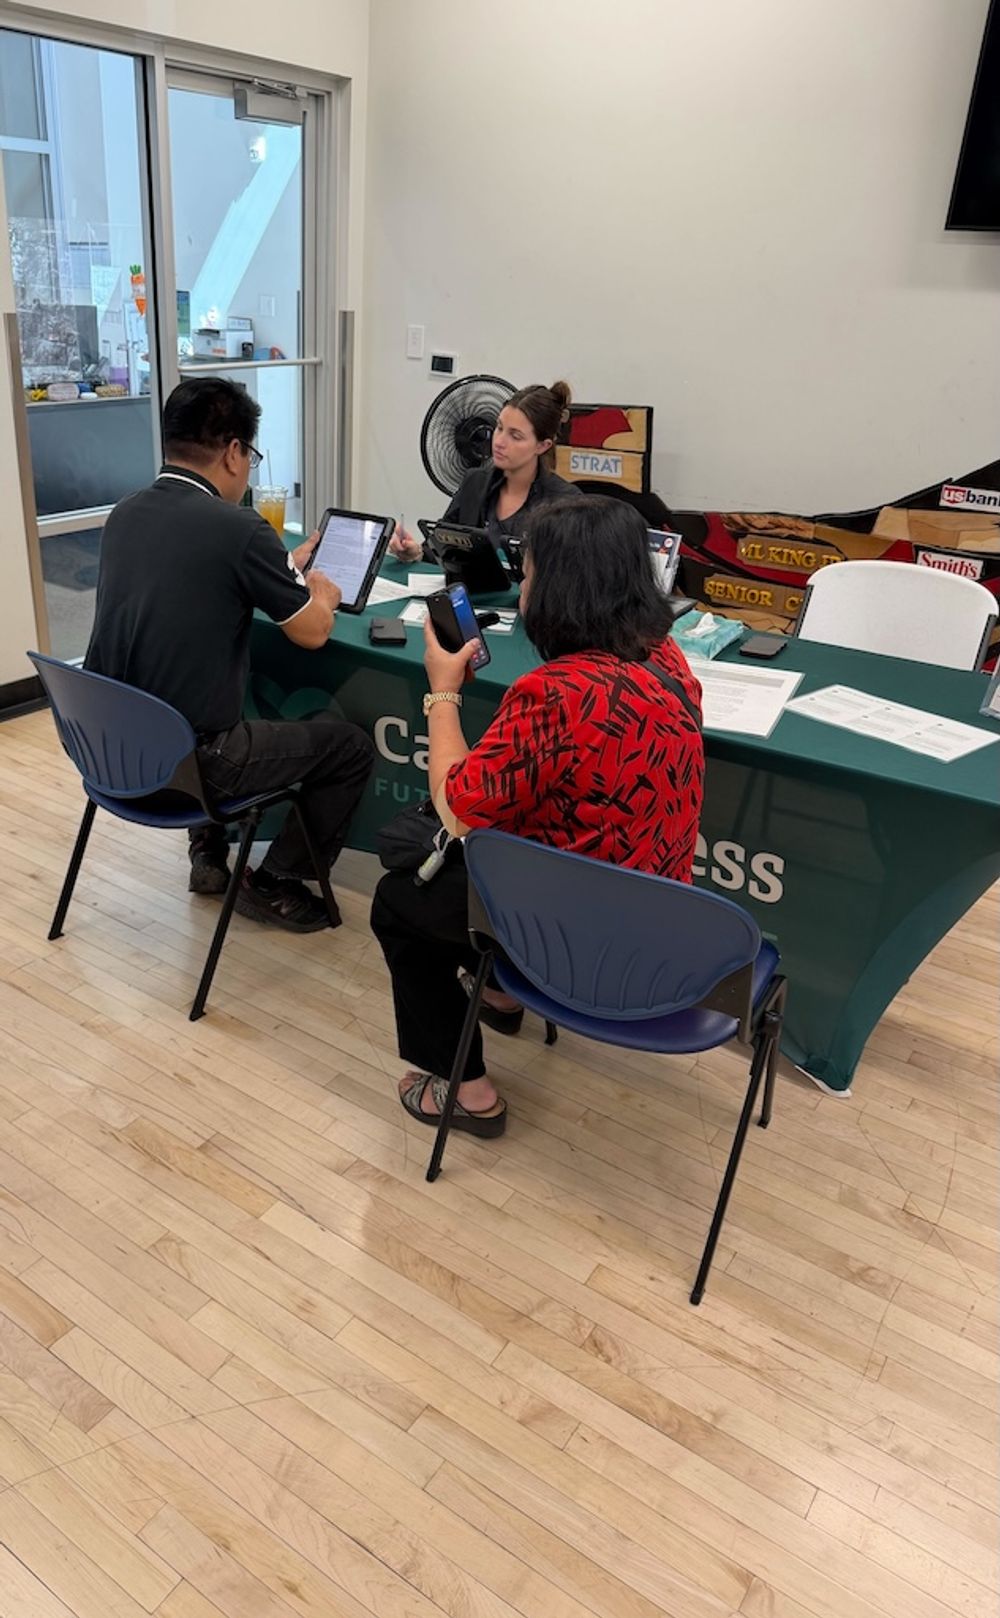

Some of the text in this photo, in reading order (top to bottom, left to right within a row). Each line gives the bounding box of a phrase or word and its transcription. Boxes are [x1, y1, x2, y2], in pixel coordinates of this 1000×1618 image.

[571, 454, 623, 473] STRAT
[943, 487, 1000, 507] usban
[768, 546, 817, 568] KING
[921, 552, 978, 578] Smith's
[704, 580, 772, 606] SENIOR
